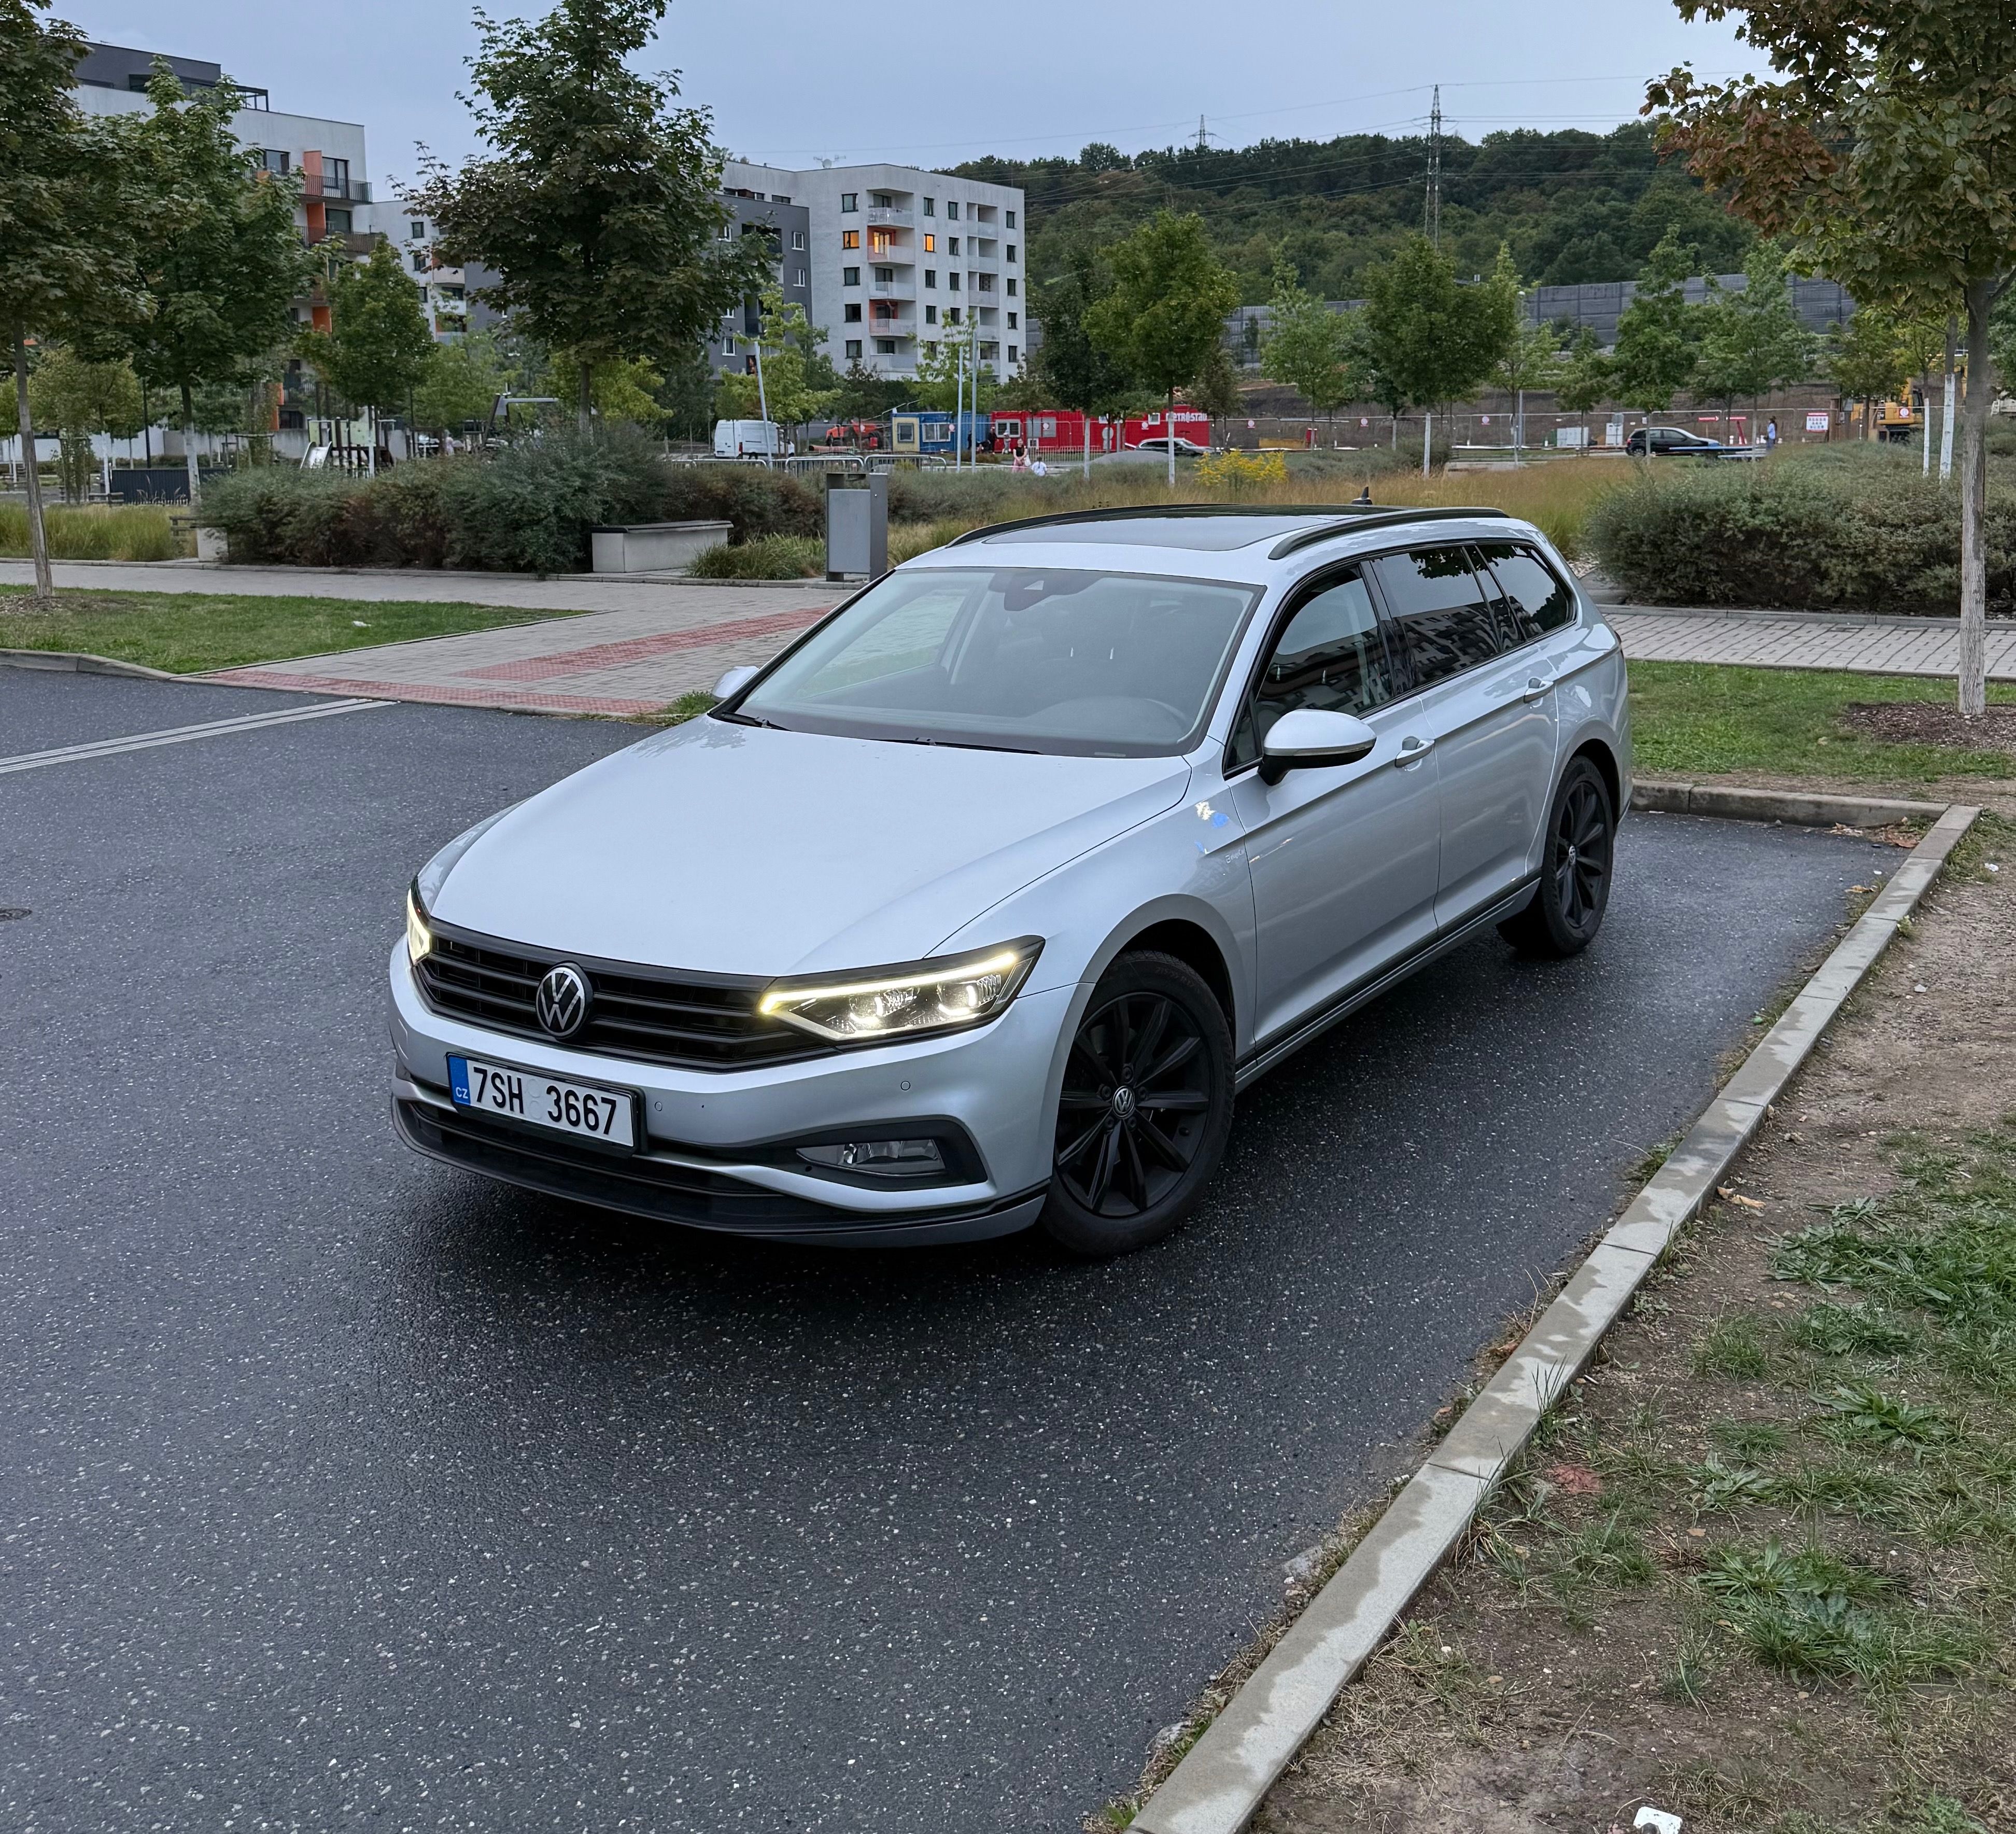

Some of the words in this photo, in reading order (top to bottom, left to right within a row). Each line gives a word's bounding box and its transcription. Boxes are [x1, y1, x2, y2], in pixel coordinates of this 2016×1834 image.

[536, 967, 585, 1037] VW
[455, 1086, 469, 1099] CZ
[473, 1067, 524, 1114] 7SH
[546, 1085, 616, 1135] 3667
